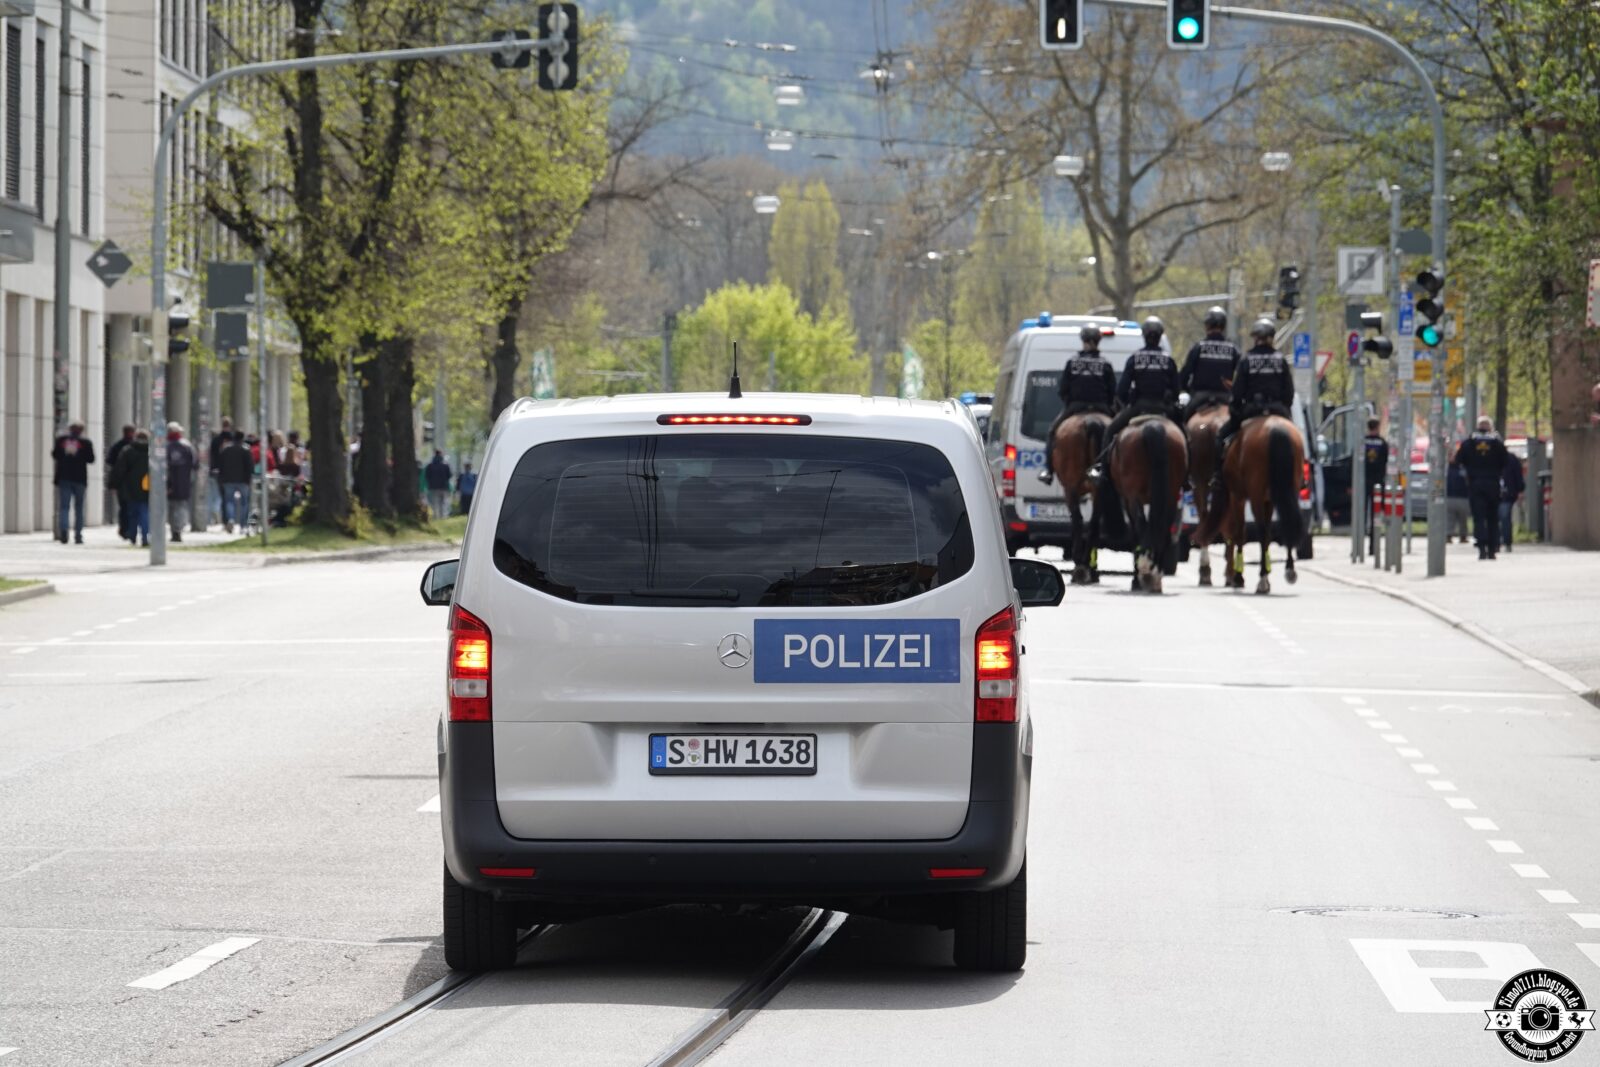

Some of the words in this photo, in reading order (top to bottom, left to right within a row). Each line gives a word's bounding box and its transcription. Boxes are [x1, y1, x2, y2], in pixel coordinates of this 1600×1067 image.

[784, 634, 931, 668] POLIZEI
[668, 739, 685, 765] S
[703, 739, 738, 765] HW
[745, 739, 811, 765] 1638
